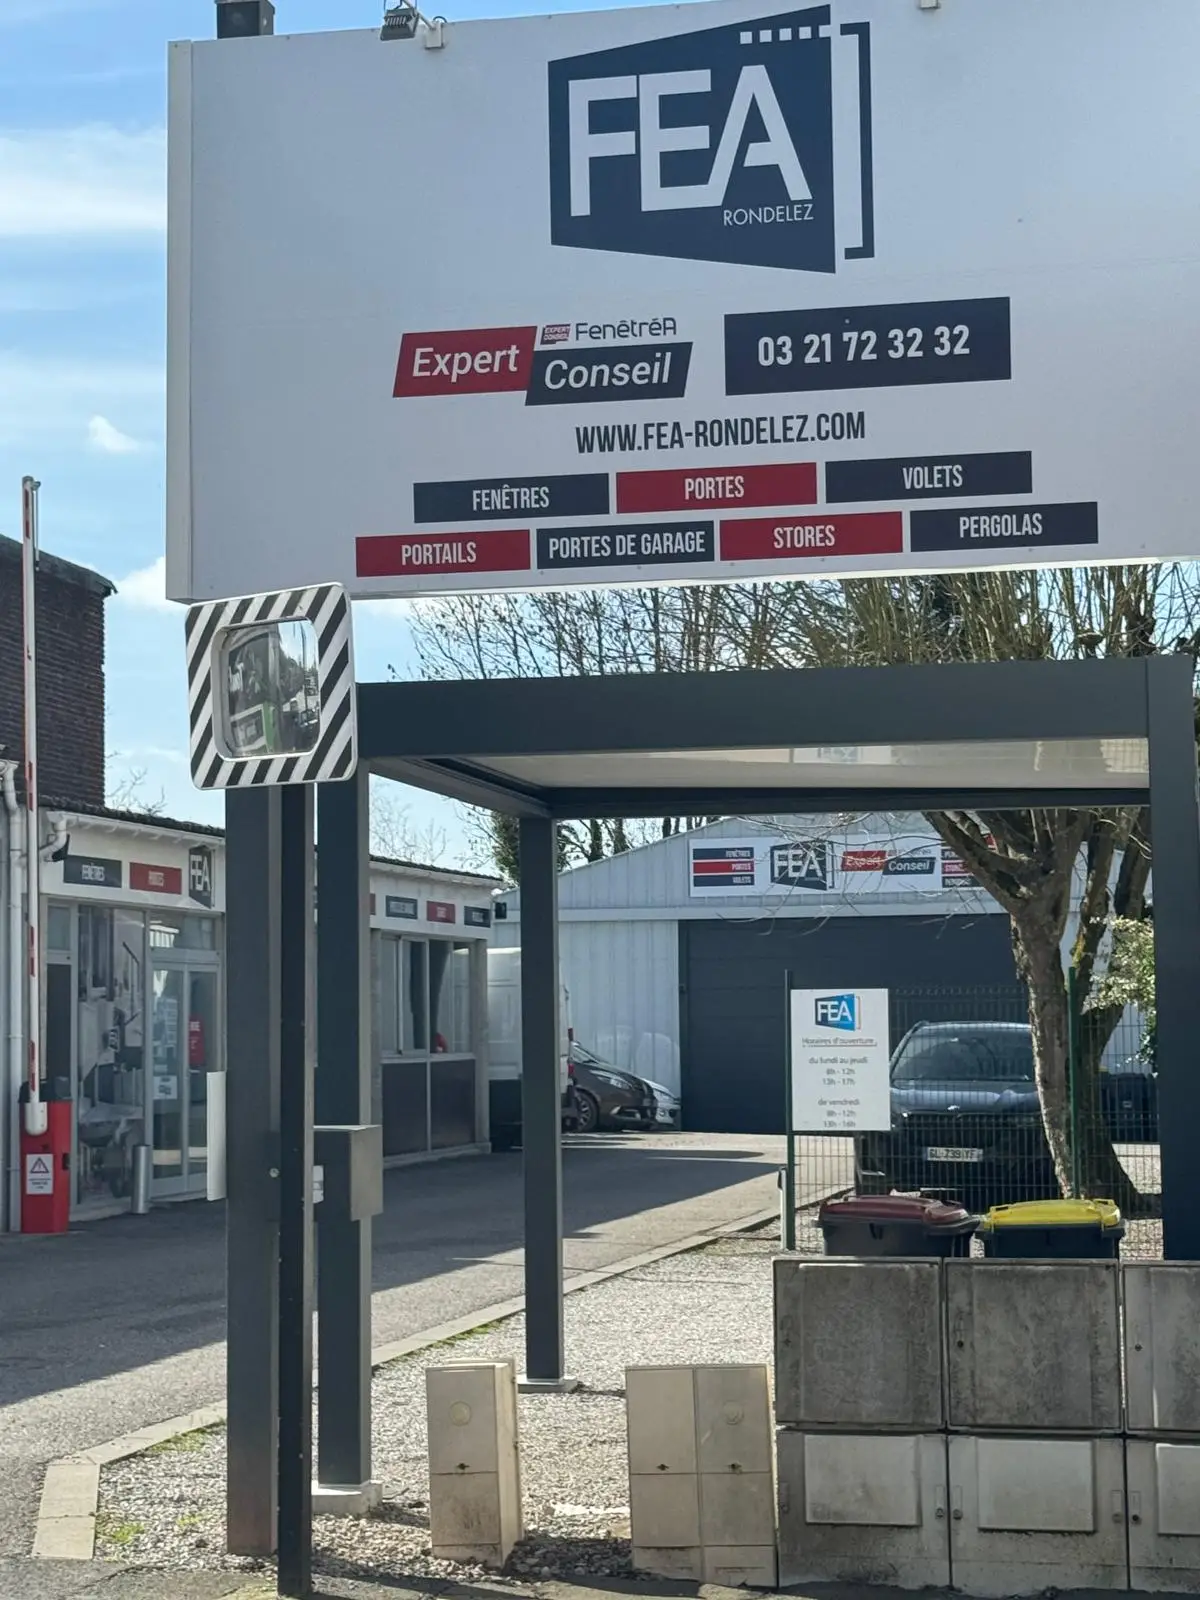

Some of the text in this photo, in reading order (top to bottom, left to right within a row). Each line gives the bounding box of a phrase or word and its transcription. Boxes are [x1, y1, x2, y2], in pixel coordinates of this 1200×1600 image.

[568, 64, 813, 217] FEA
[723, 204, 814, 226] RONDELEZ
[757, 324, 970, 366] 03 21 72 32 32
[412, 344, 520, 383] Expert
[544, 352, 672, 390] Conseil
[575, 411, 865, 453] WWW.FEA-RONDELEZ.COM
[684, 475, 745, 500] PORTES
[902, 465, 963, 490] VOLETS
[472, 484, 549, 511] FENÊTRES
[773, 525, 836, 549] STORES
[959, 513, 1043, 538] PERGOLAS
[401, 542, 477, 566] PORTAILS
[549, 531, 706, 559] PORTES DE GARAGE
[190, 854, 211, 892] FEA
[774, 850, 823, 878] FEA
[888, 860, 930, 872] Conseil
[817, 1000, 853, 1022] FEA
[820, 1056, 838, 1064] lundi
